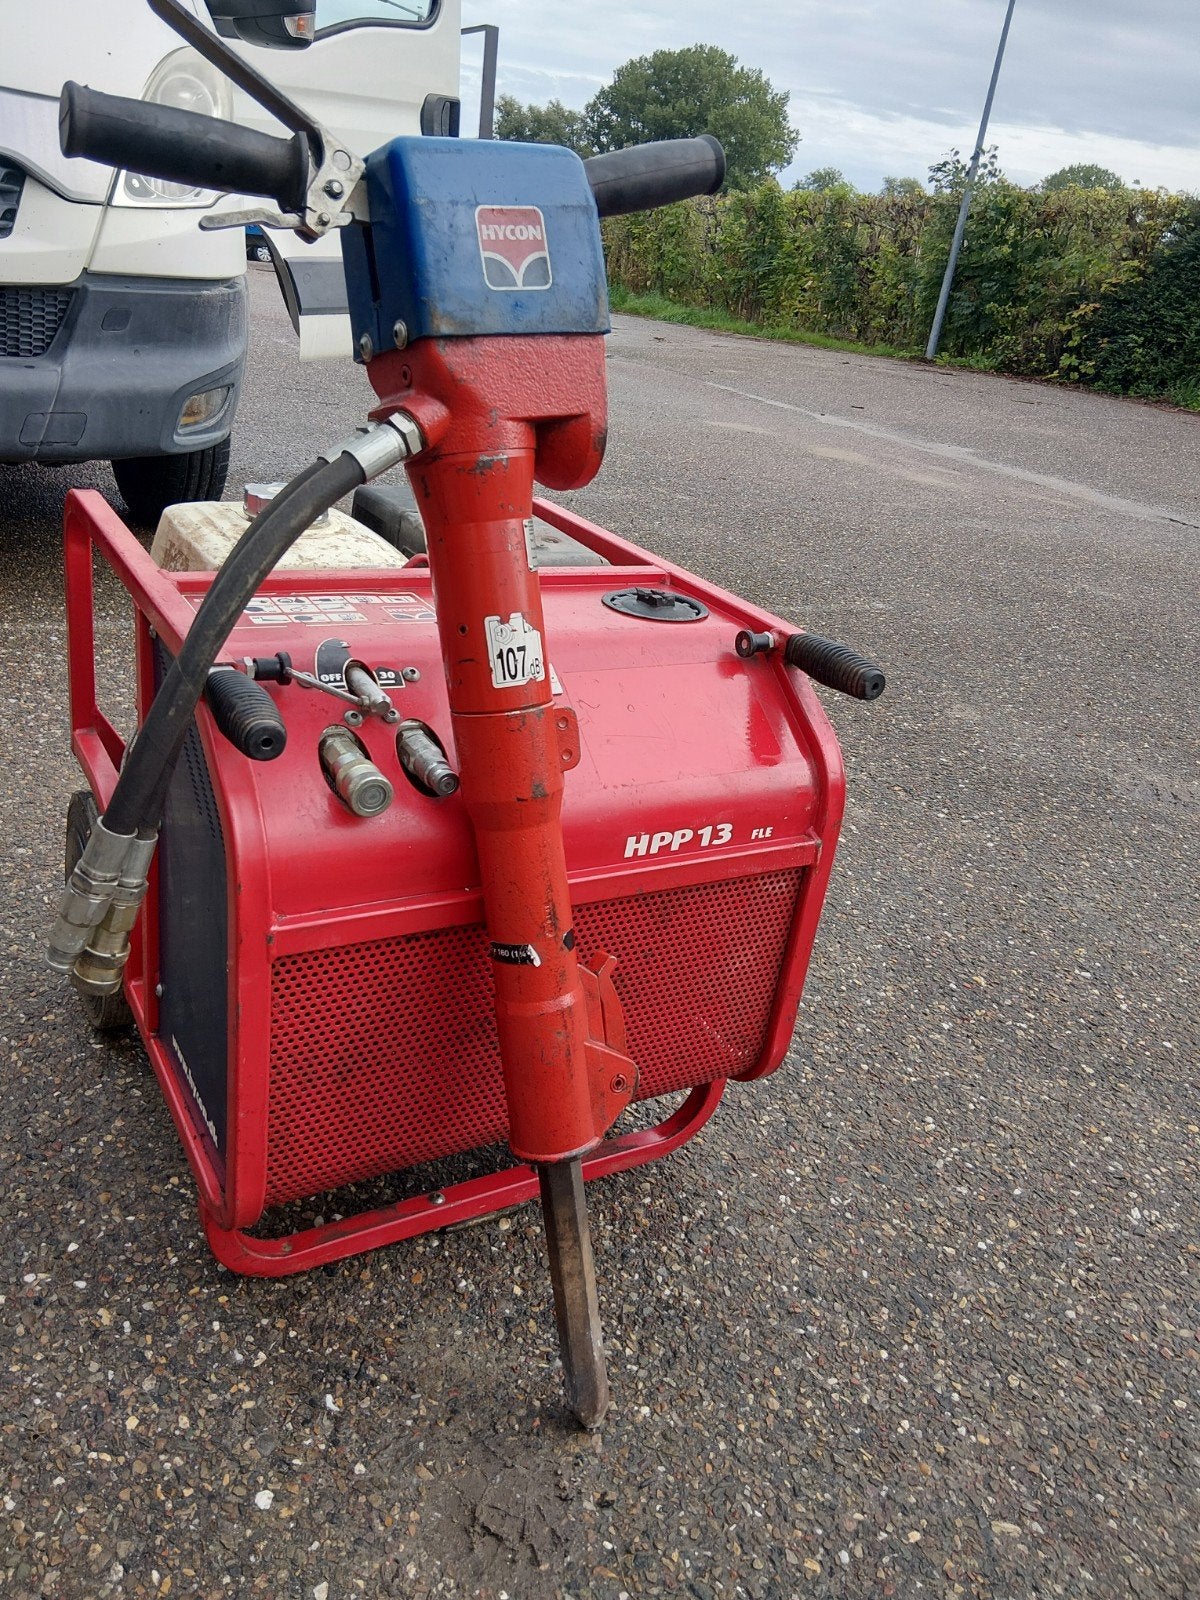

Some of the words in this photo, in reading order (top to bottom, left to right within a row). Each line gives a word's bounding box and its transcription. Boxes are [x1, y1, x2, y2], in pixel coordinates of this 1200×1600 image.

[481, 224, 542, 241] HYCON
[496, 645, 526, 681] 107
[530, 658, 541, 677] dB
[320, 673, 342, 682] OFF
[379, 671, 396, 680] 30
[750, 826, 774, 840] FLE
